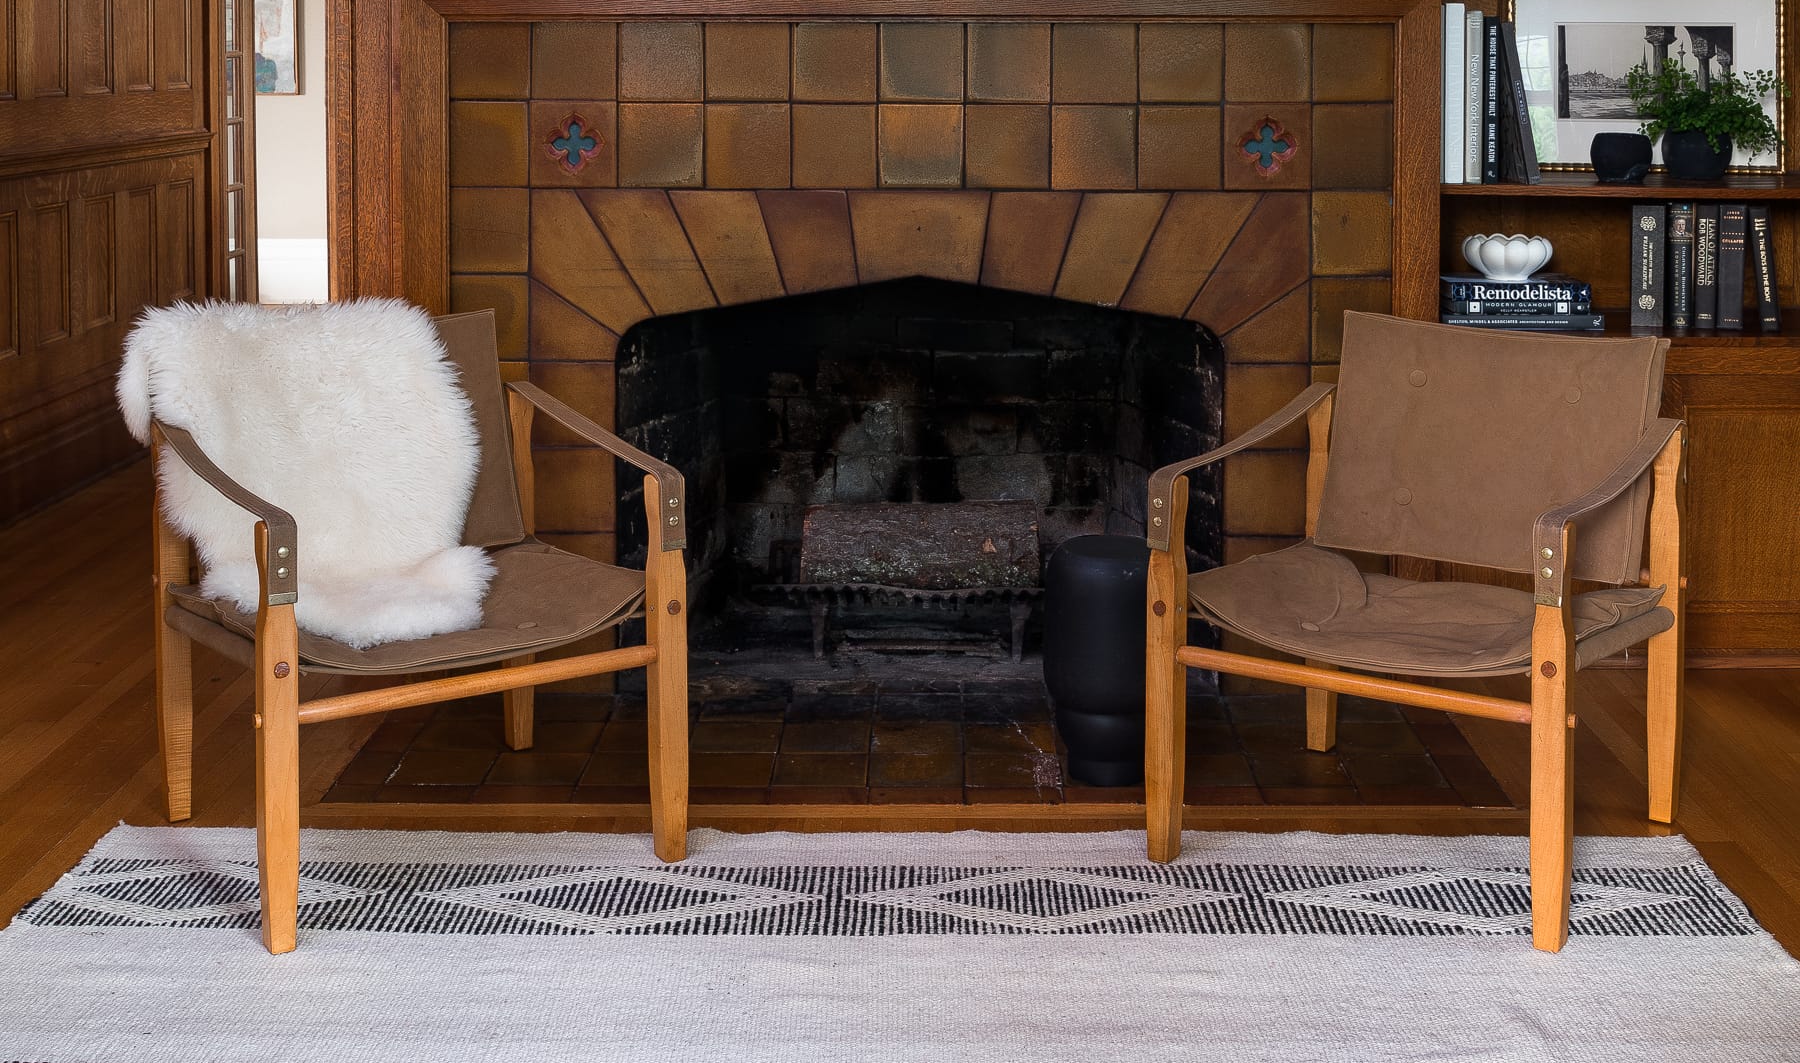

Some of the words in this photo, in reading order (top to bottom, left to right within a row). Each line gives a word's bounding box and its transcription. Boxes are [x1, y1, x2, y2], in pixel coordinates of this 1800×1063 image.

[1489, 25, 1497, 36] THE
[1471, 54, 1479, 75] New
[1471, 77, 1479, 100] New
[1470, 101, 1479, 121] York
[1488, 101, 1496, 116] BUILT
[1470, 123, 1479, 163] Interiors
[1698, 218, 1706, 234] BOB
[1708, 219, 1716, 239] PLAN
[1708, 242, 1715, 252] OF
[1697, 236, 1706, 286] WOODWARD
[1707, 254, 1715, 286] ATTACK
[1762, 266, 1768, 274] IN
[1473, 285, 1573, 301] Remodelista
